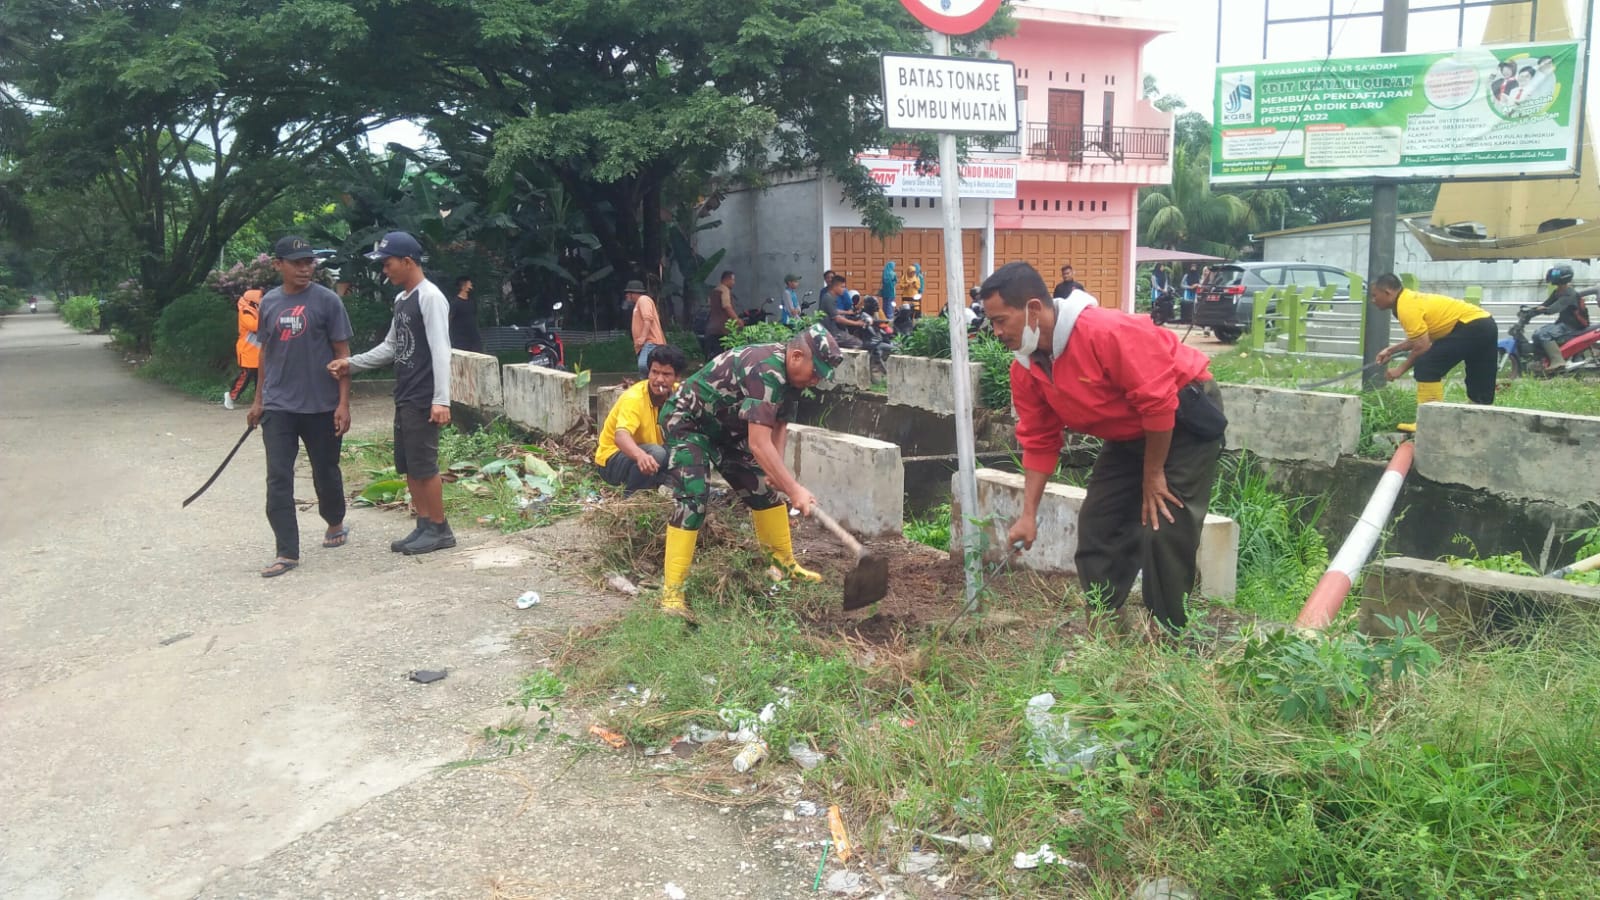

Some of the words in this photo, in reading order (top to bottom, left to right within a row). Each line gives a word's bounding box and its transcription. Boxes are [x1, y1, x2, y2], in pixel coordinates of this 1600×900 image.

[899, 67, 943, 88] BATAS
[947, 70, 1001, 91] TONASE
[1262, 67, 1305, 76] YAYASAN
[1261, 93, 1320, 105] MEMBUKA
[1323, 89, 1413, 100] PENDAFTARAN
[898, 98, 947, 119] SUMBU
[951, 101, 1007, 121] MUATAN
[1261, 105, 1312, 115] PESERTA
[1314, 103, 1347, 111] DIDIK
[1350, 101, 1384, 110] BARU
[1303, 113, 1329, 122] 2022
[902, 163, 913, 177] PT.
[983, 166, 1014, 179] MANDIRI
